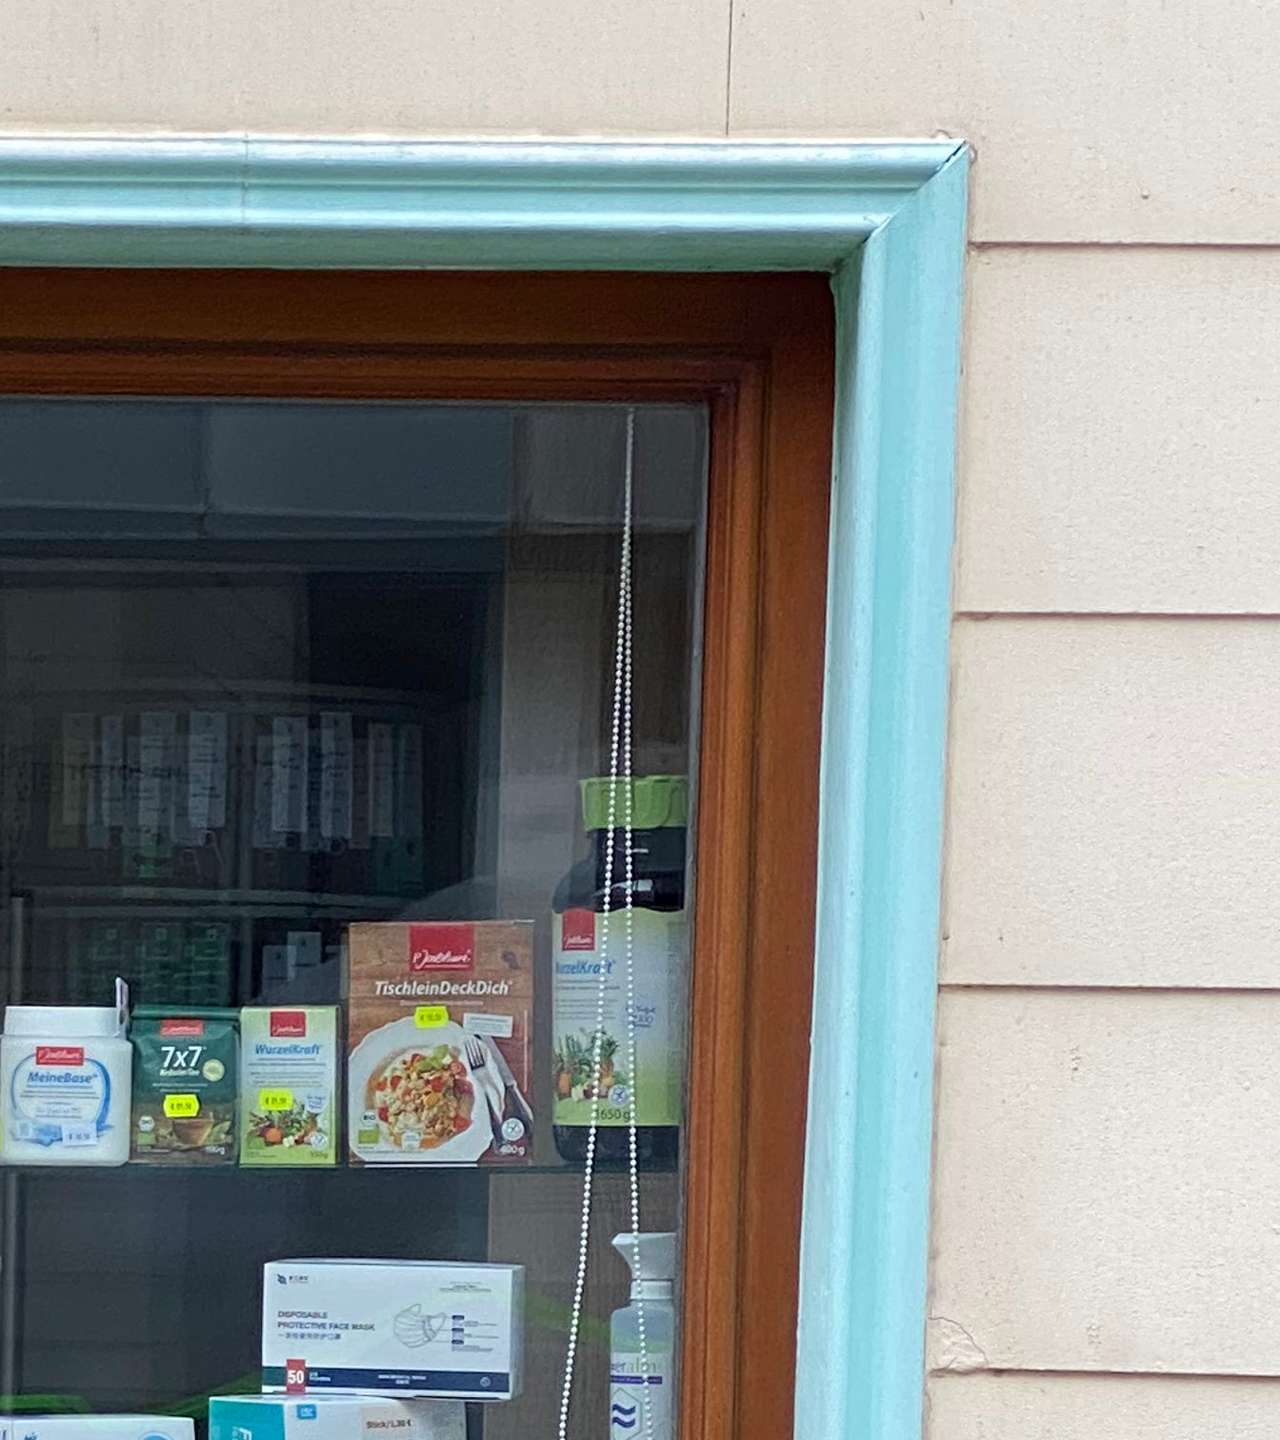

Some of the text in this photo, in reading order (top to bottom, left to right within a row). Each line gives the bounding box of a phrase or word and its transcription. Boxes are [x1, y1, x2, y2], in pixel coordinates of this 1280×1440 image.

[374, 980, 509, 997] TischleinDeckDich
[255, 1044, 321, 1056] WurzelKraft
[160, 1046, 203, 1068] 7x7
[26, 1072, 93, 1084] MeineBase
[277, 1310, 329, 1320] DISPOSABLE
[277, 1321, 376, 1332] PROTECTIVE FACE MASK
[286, 1369, 306, 1385] 50
